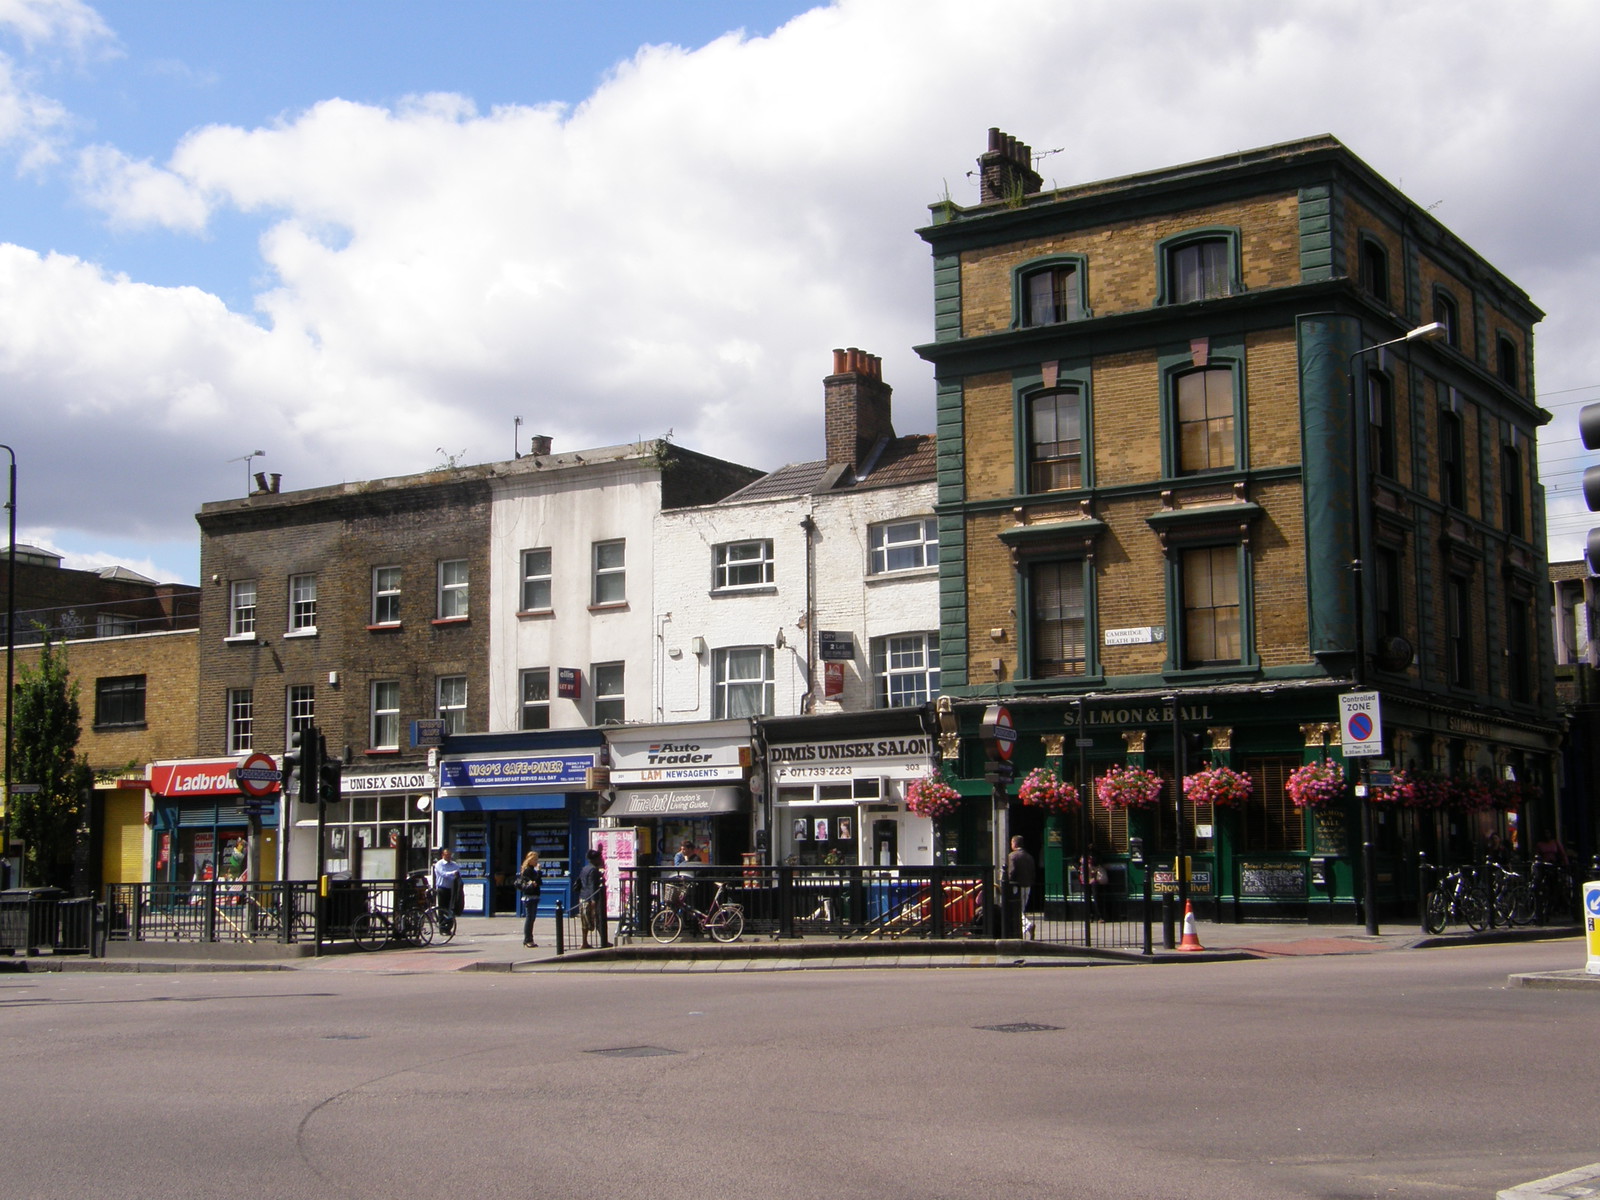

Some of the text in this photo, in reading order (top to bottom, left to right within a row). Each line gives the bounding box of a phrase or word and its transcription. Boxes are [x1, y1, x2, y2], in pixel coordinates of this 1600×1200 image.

[1106, 630, 1142, 638] CAMBRIDGE
[559, 670, 574, 678] ellis
[1341, 694, 1376, 703] Controlled
[1347, 702, 1371, 712] ZONE
[1146, 707, 1160, 722] &
[1162, 705, 1213, 721] BALL
[659, 743, 700, 754] Auto
[771, 738, 931, 762] DIMI'S UNISEX SALON
[647, 752, 713, 765] Trader
[468, 763, 501, 776] NICO'S
[905, 763, 920, 771] 303
[236, 768, 283, 781] UNDERGROUND
[641, 770, 662, 781] LAM
[666, 769, 719, 779] NEWSAGENTS
[174, 772, 240, 792] Ladbrok
[350, 777, 388, 790] UNISEX
[390, 775, 425, 788] SALON
[628, 794, 668, 812] Time Out
[671, 793, 701, 802] London's
[670, 801, 689, 810] Living
[1190, 883, 1210, 892] live!
